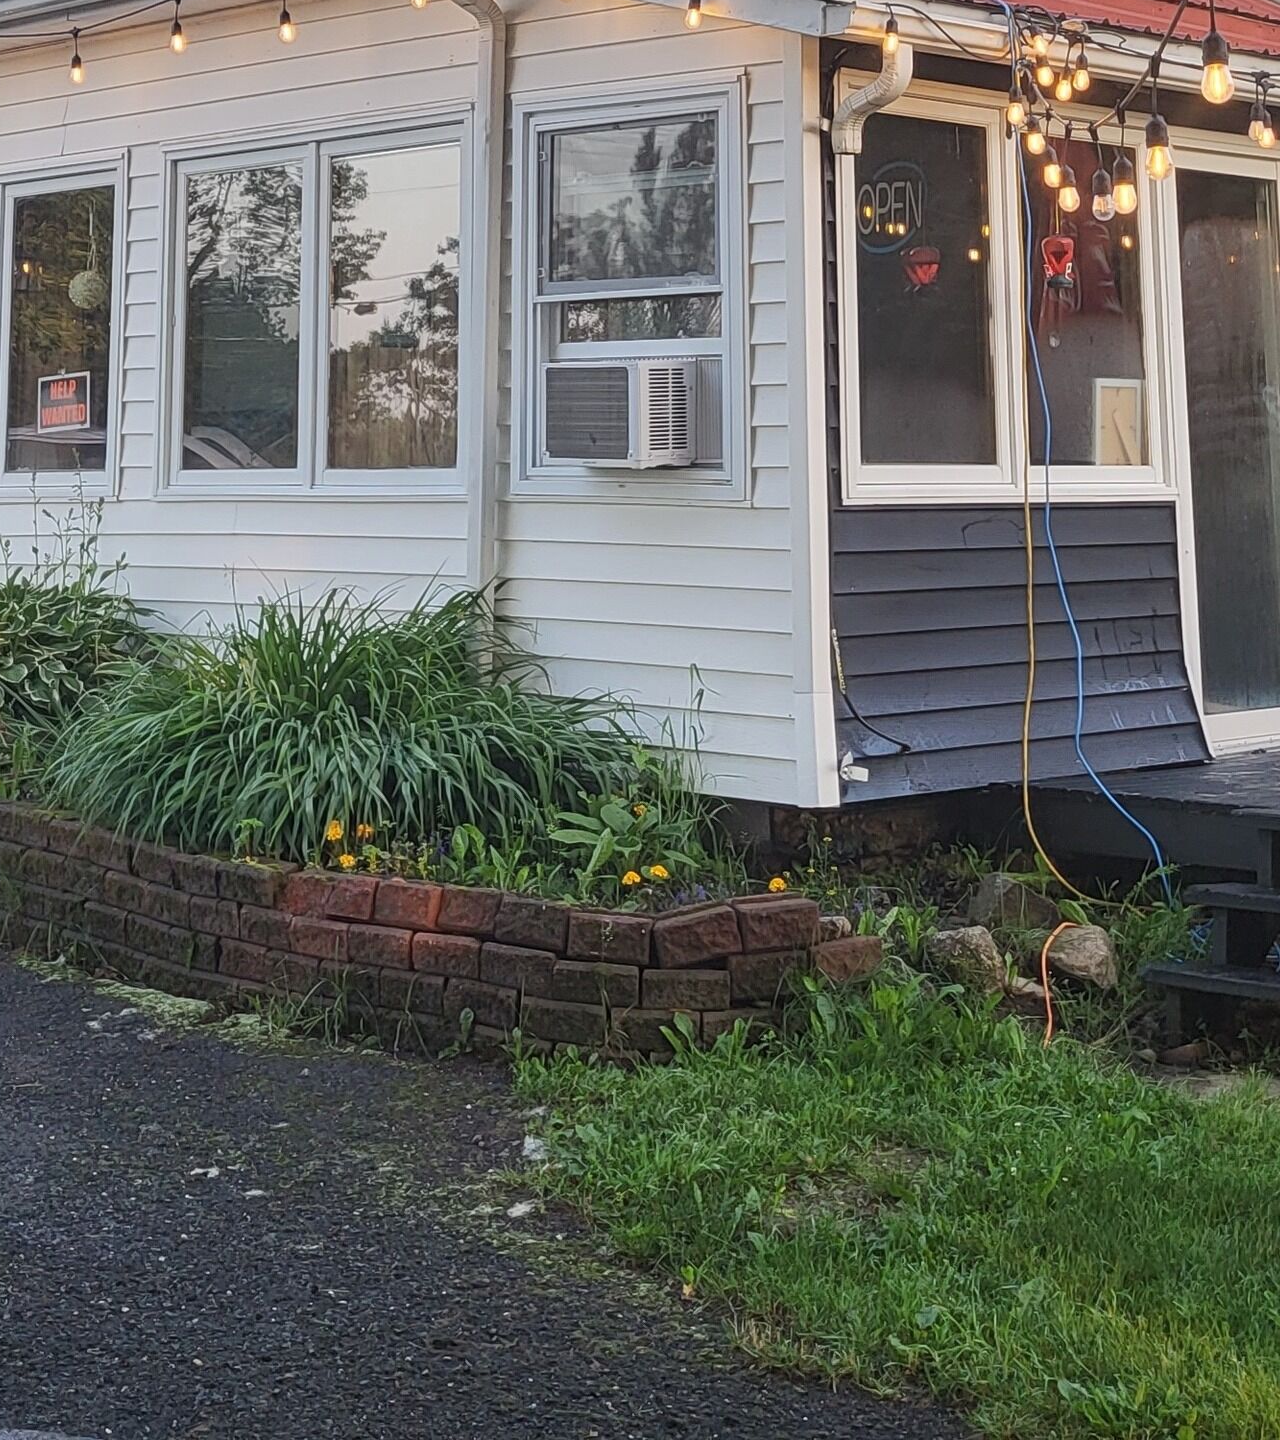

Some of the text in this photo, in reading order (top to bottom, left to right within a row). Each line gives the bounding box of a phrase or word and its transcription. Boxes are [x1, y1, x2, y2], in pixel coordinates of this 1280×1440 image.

[857, 180, 922, 235] OPEN
[50, 379, 77, 400] HELP
[42, 403, 86, 427] WANTED
